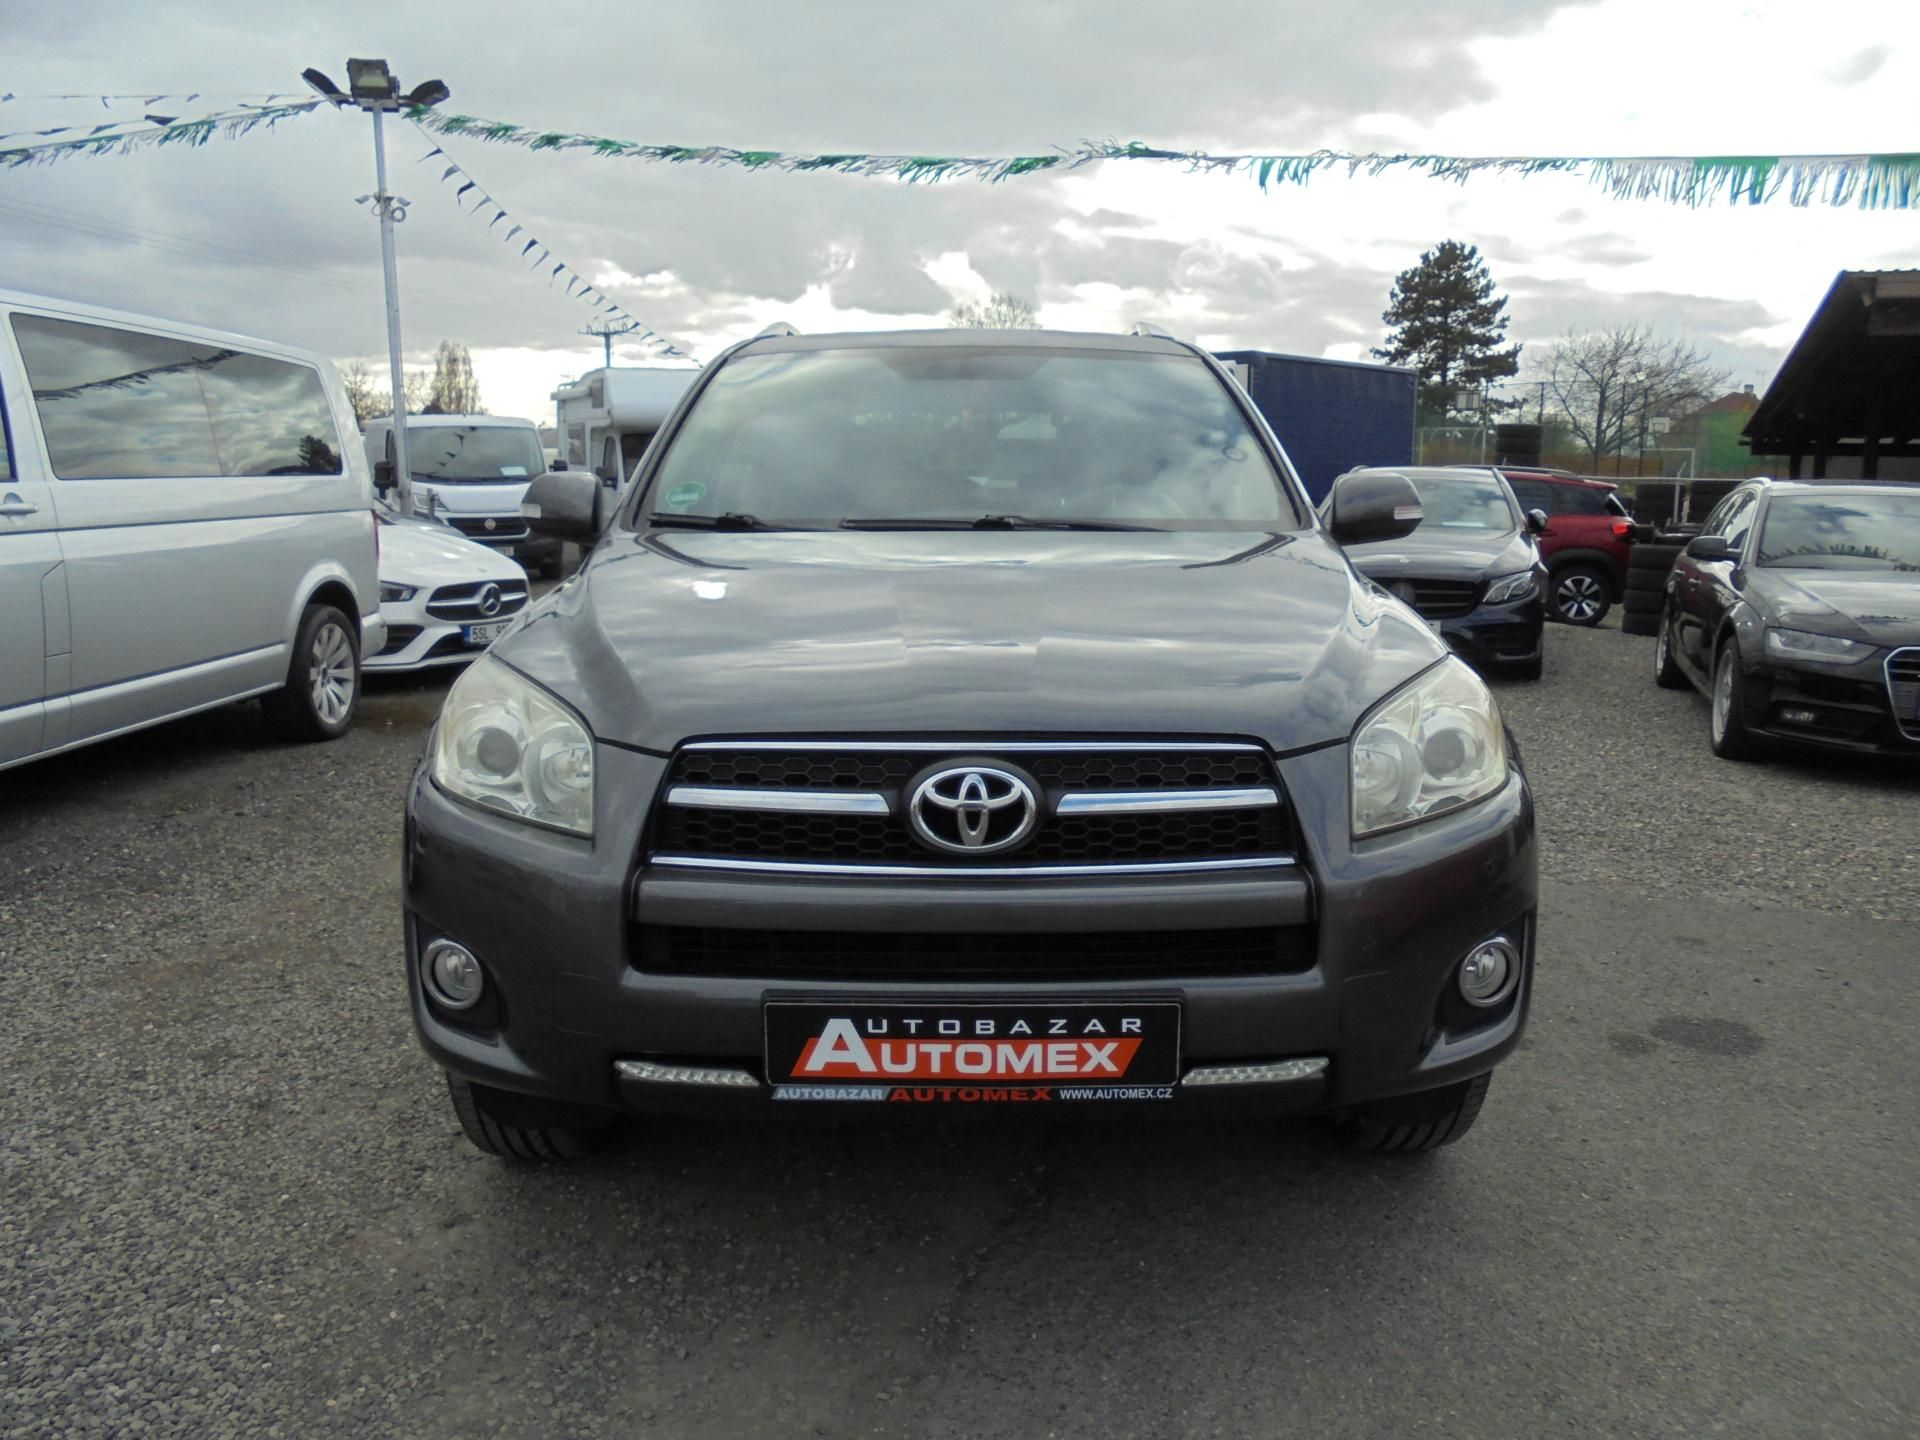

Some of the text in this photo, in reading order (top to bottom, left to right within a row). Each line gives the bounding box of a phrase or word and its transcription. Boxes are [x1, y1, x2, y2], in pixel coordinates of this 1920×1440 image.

[804, 1018, 1120, 1074] AUTOMEX
[775, 1087, 1173, 1101] AUTOBAZAR AUTOMEX WWW.AUTOMEX.CZ
